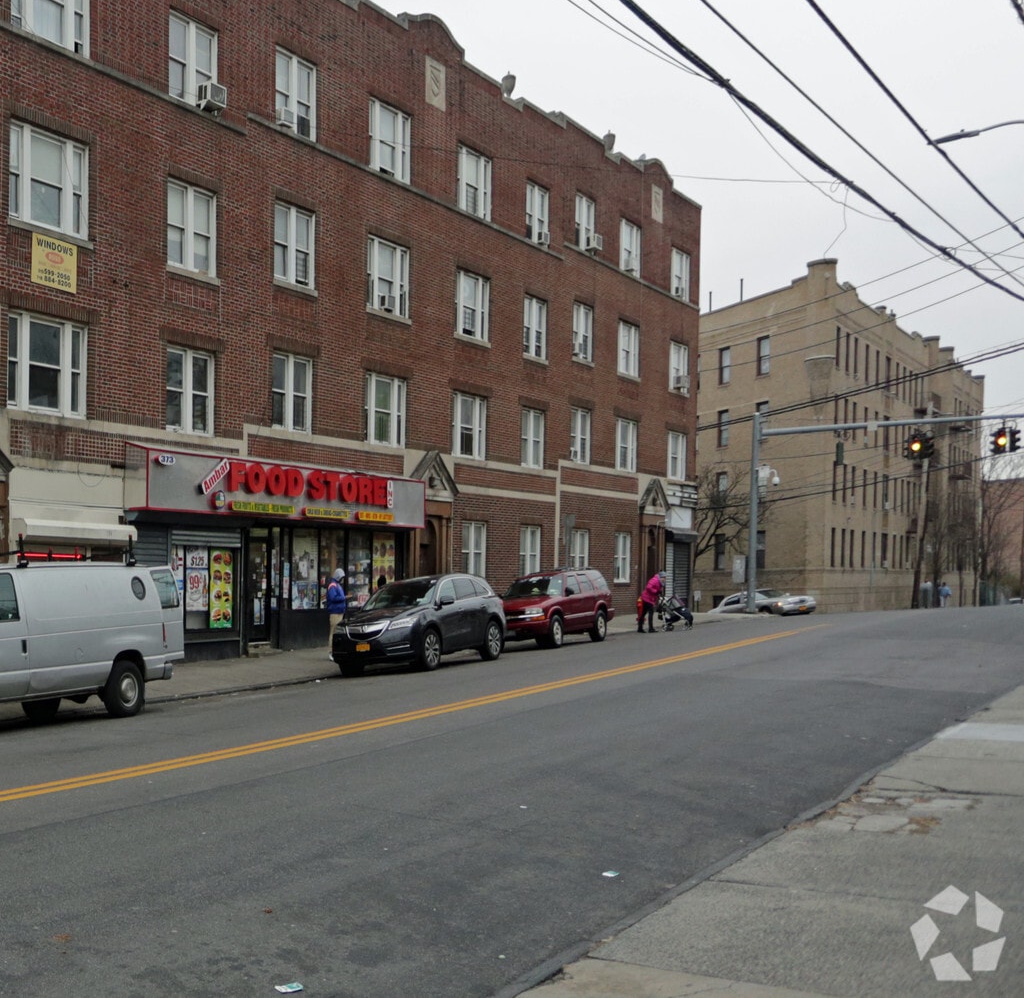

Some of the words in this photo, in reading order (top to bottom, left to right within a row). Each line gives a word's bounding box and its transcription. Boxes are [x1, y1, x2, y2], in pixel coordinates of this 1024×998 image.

[36, 237, 74, 257] WINDOWS
[203, 461, 229, 493] Ambar
[229, 461, 304, 497] FOOD
[307, 470, 388, 506] STORE
